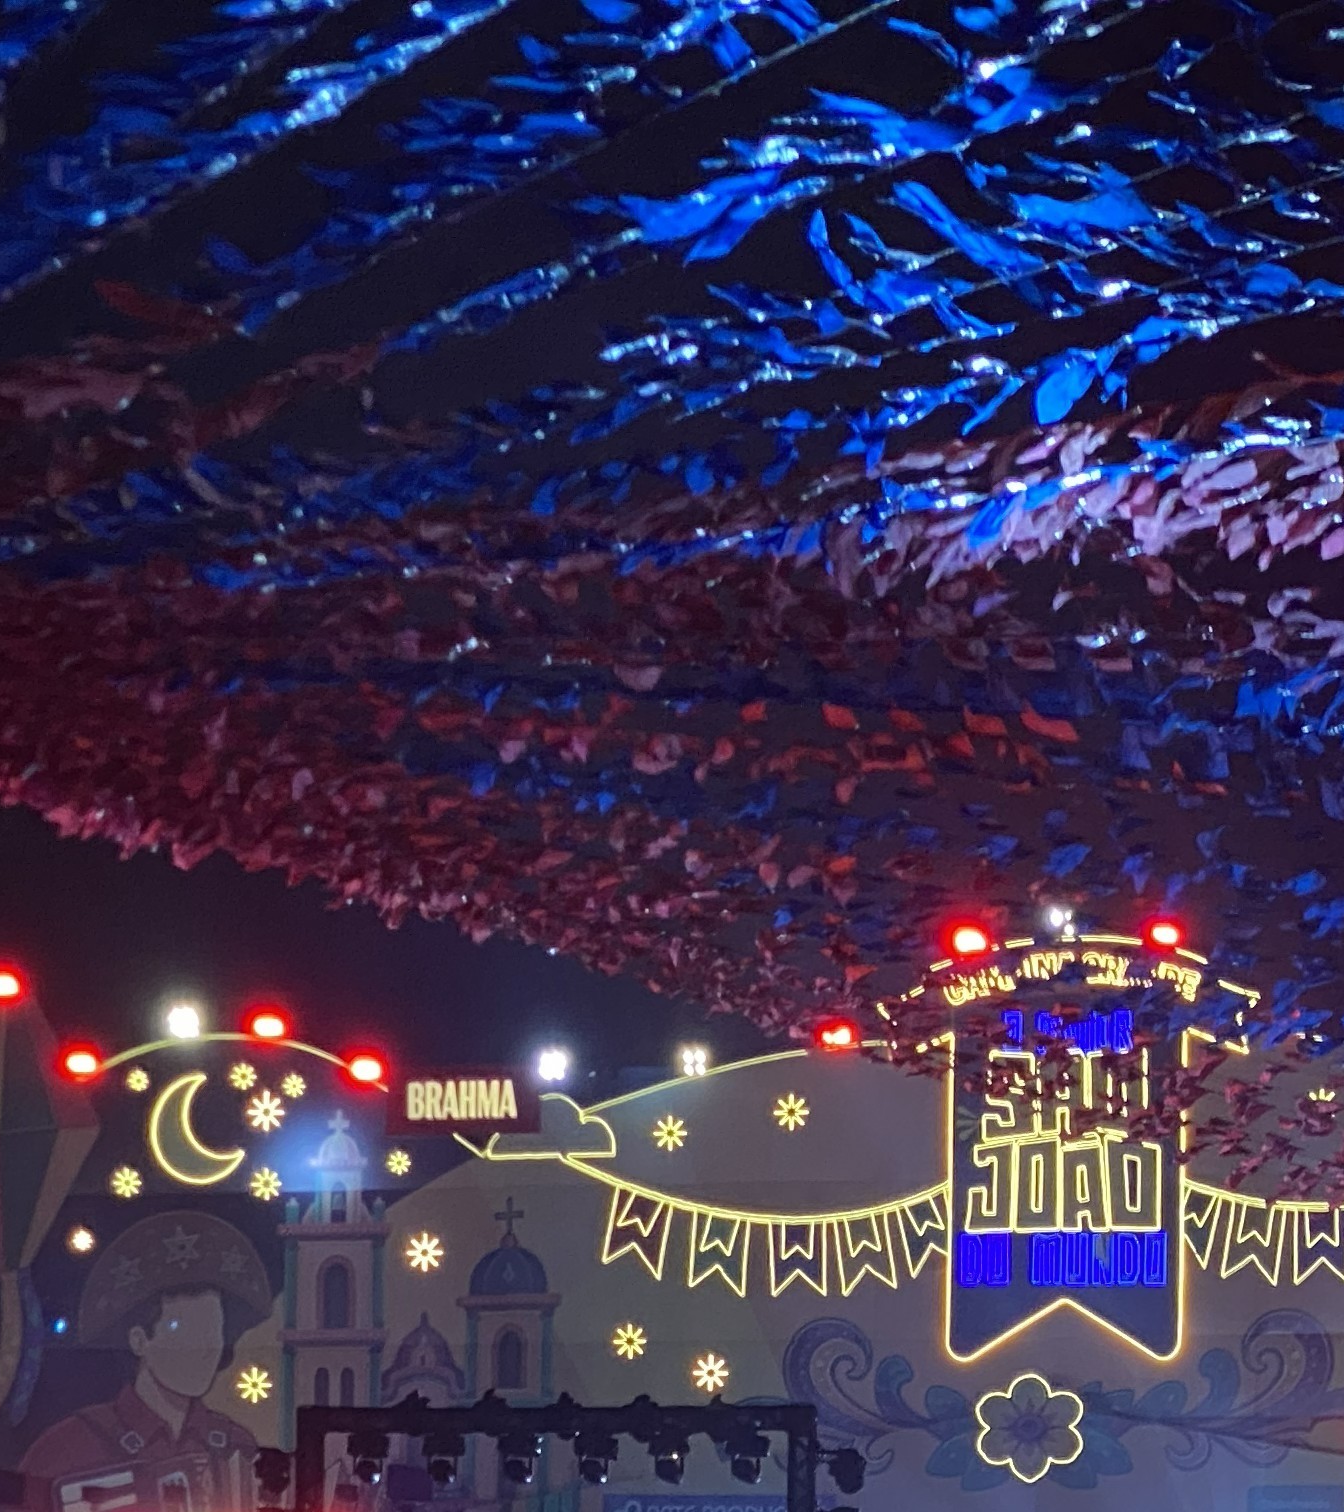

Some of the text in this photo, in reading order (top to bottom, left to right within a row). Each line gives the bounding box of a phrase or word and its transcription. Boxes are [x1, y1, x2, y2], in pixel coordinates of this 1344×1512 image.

[406, 1078, 518, 1121] BRAHMA
[958, 1231, 1168, 1287] DO MUNDO
